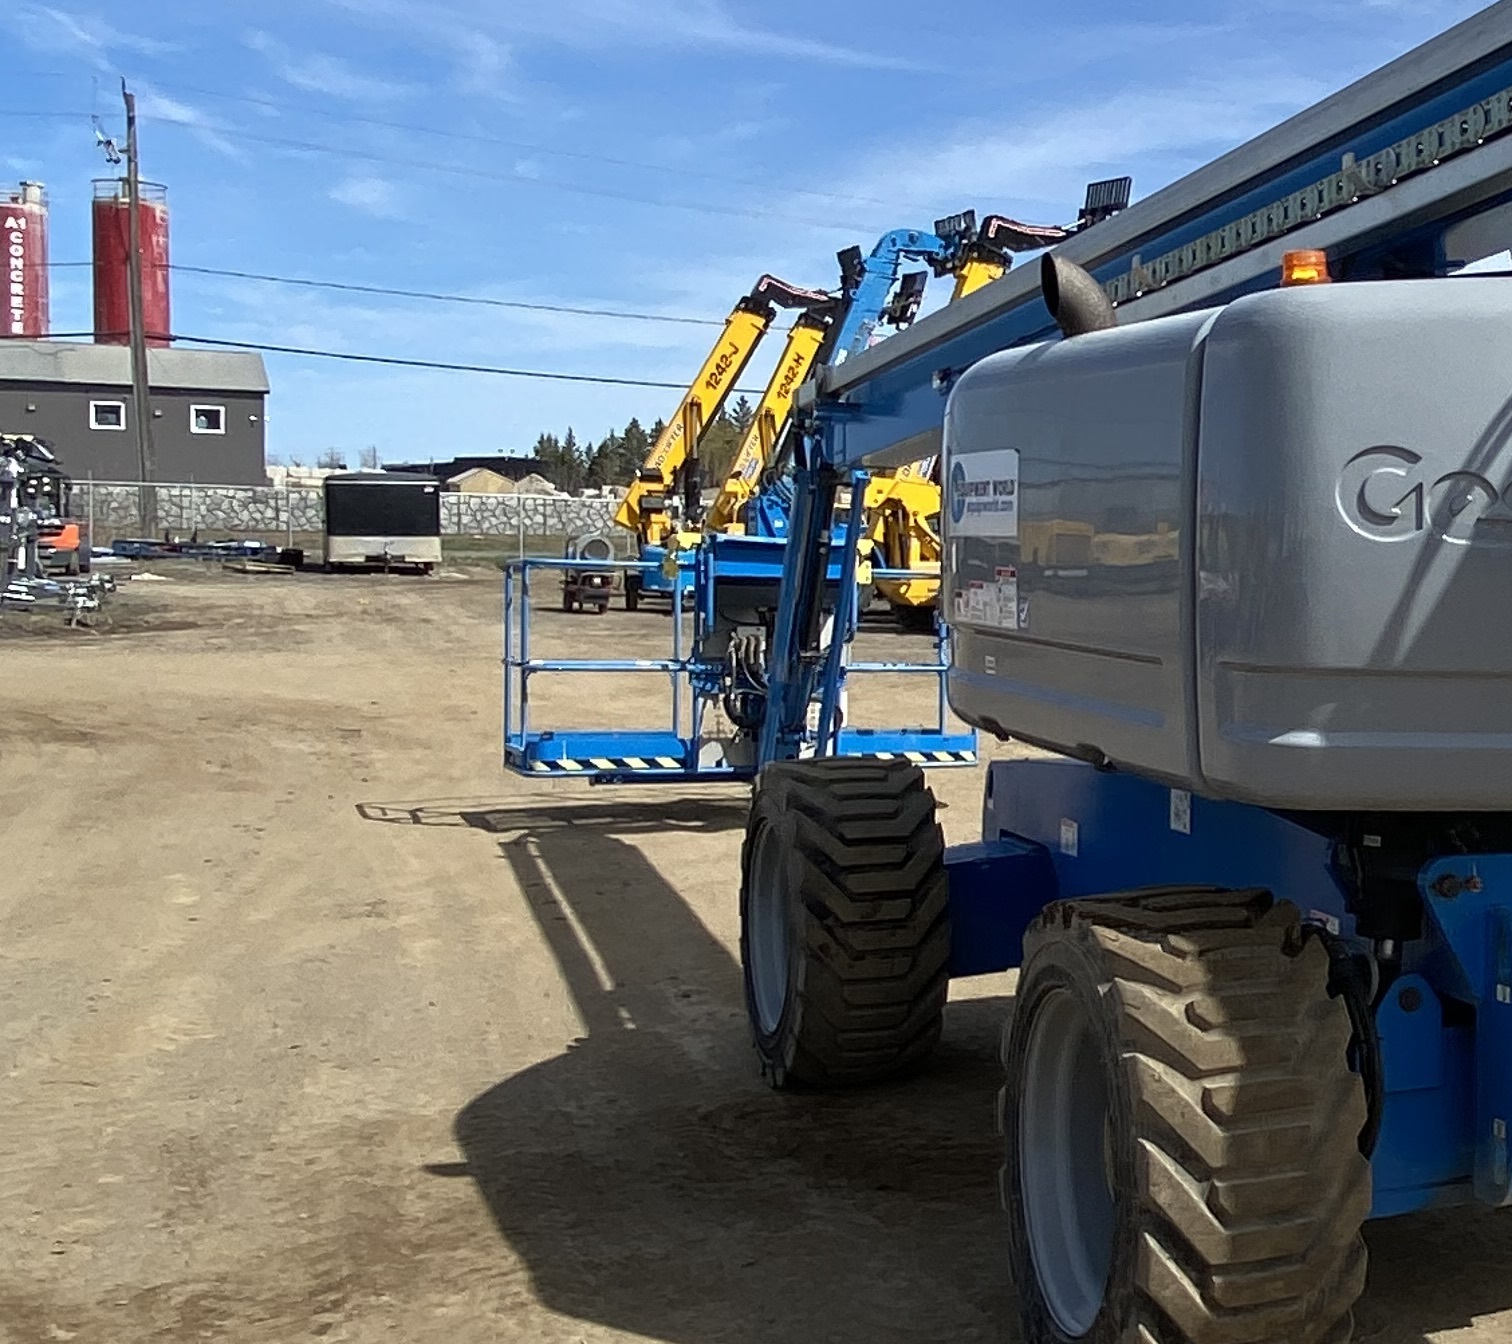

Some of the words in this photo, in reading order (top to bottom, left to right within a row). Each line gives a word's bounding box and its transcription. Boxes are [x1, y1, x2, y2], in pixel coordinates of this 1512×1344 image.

[4, 216, 27, 230] A1
[9, 231, 25, 335] CONCRETE
[705, 346, 740, 391] 1242-J
